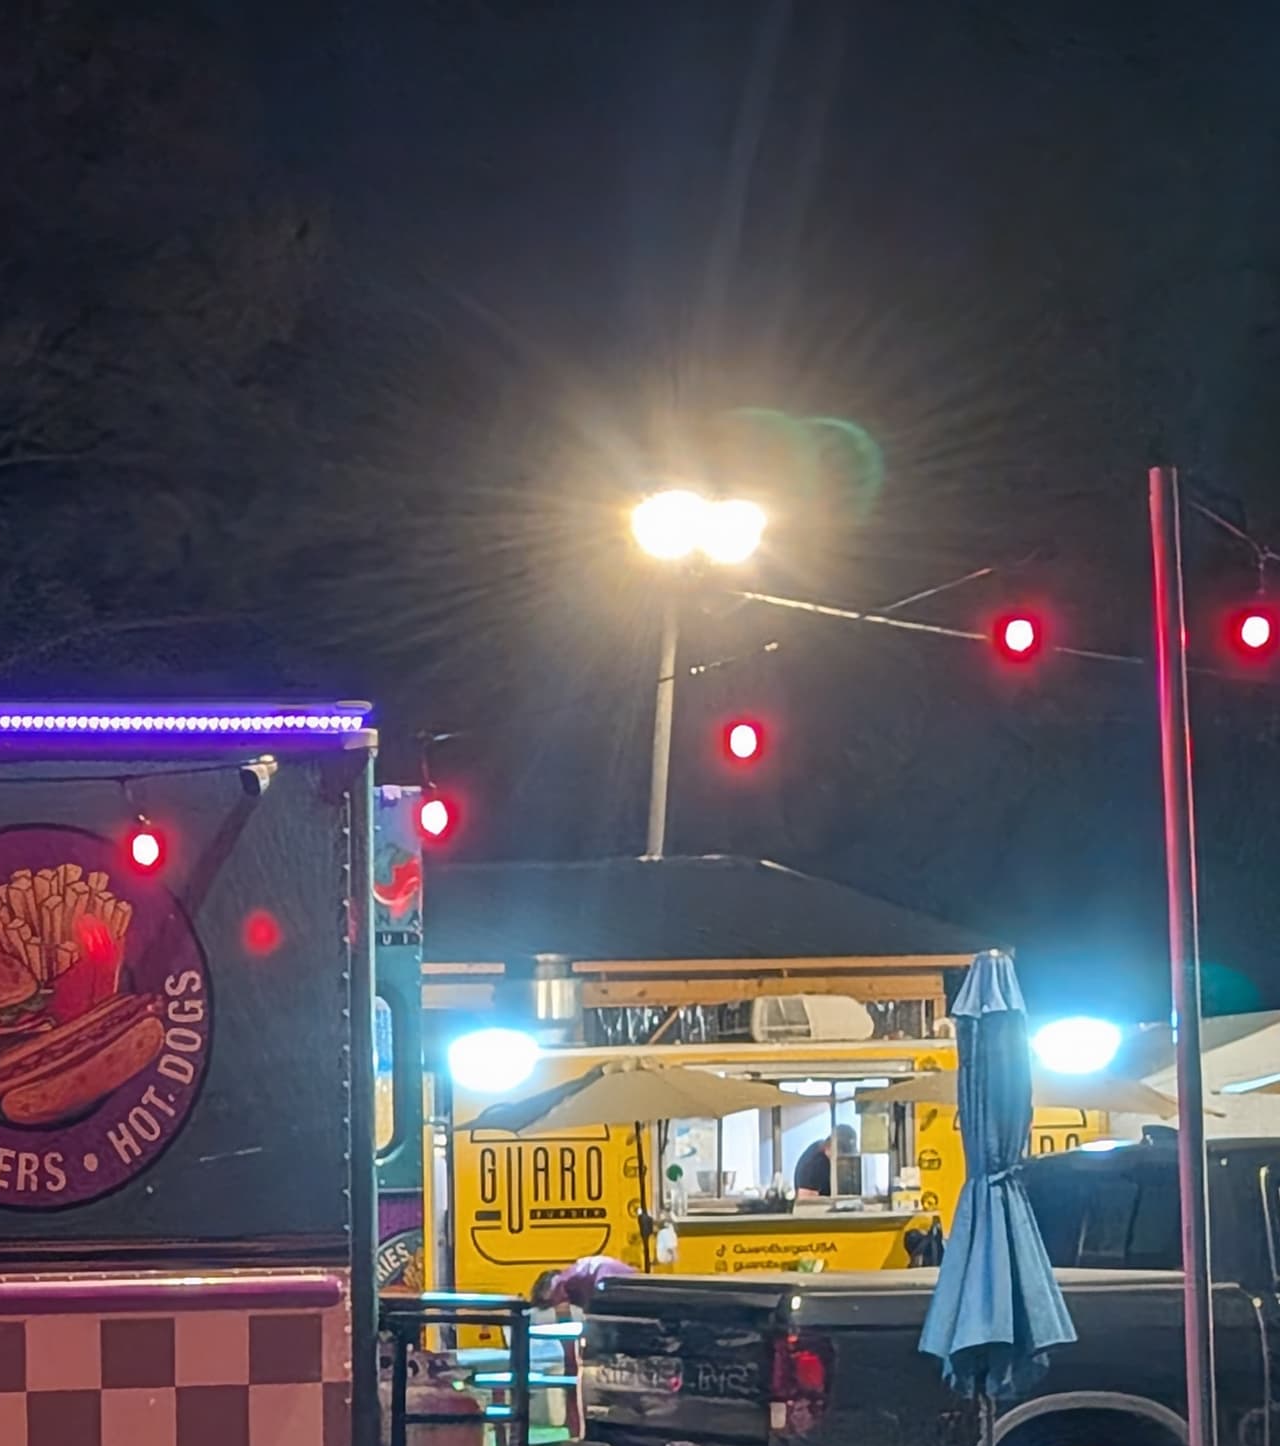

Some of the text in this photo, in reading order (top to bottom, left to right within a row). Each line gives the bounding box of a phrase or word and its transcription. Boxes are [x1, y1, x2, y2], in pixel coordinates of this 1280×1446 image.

[107, 1085, 178, 1165] HOT
[157, 970, 203, 1085] DOGS
[480, 1145, 603, 1234] GUARO
